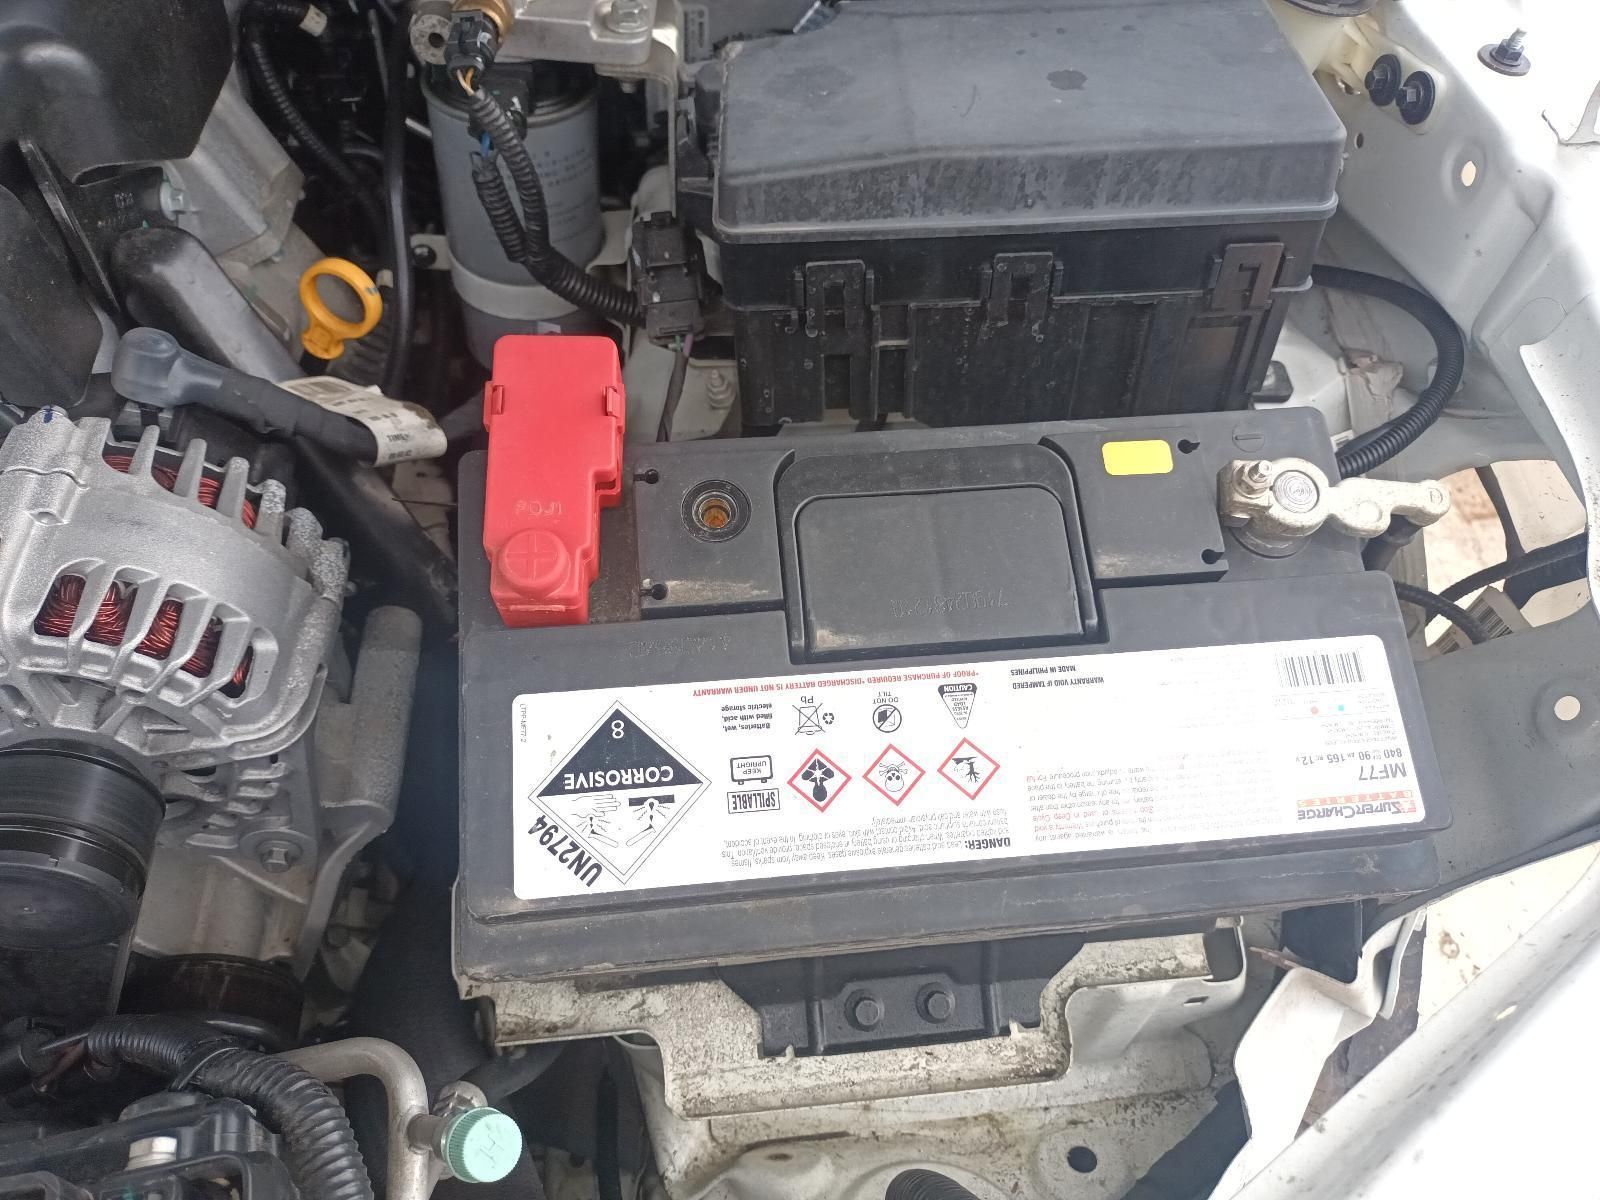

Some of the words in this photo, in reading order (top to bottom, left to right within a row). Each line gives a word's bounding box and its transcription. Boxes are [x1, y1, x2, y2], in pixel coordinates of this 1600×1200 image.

[1011, 667, 1048, 676] PHILIPPINES
[867, 675, 901, 683] REQUIRED
[903, 673, 940, 681] PURCHASE
[1070, 677, 1104, 685] WARRANTY
[785, 681, 815, 689] BATTERY
[944, 684, 973, 693] CAUTION
[1013, 681, 1045, 689] TAMPERED
[693, 688, 732, 696] WARRANTY
[801, 696, 813, 704] Pb
[873, 696, 886, 705] NOT
[888, 696, 898, 705] DO
[612, 718, 625, 738] 8
[1358, 751, 1371, 760] 90
[1384, 748, 1402, 758] 840
[1302, 756, 1314, 765] 12
[1327, 754, 1345, 763] 165
[736, 759, 768, 769] UPRIGHT
[742, 767, 762, 775] KEEP
[1359, 762, 1407, 780] MF77
[564, 764, 675, 789] CORROSIVE
[731, 790, 777, 810] SPILLABLE
[1296, 791, 1410, 808] BATTERIES
[965, 837, 1010, 850] DANGER:
[527, 814, 603, 887] UN2794
